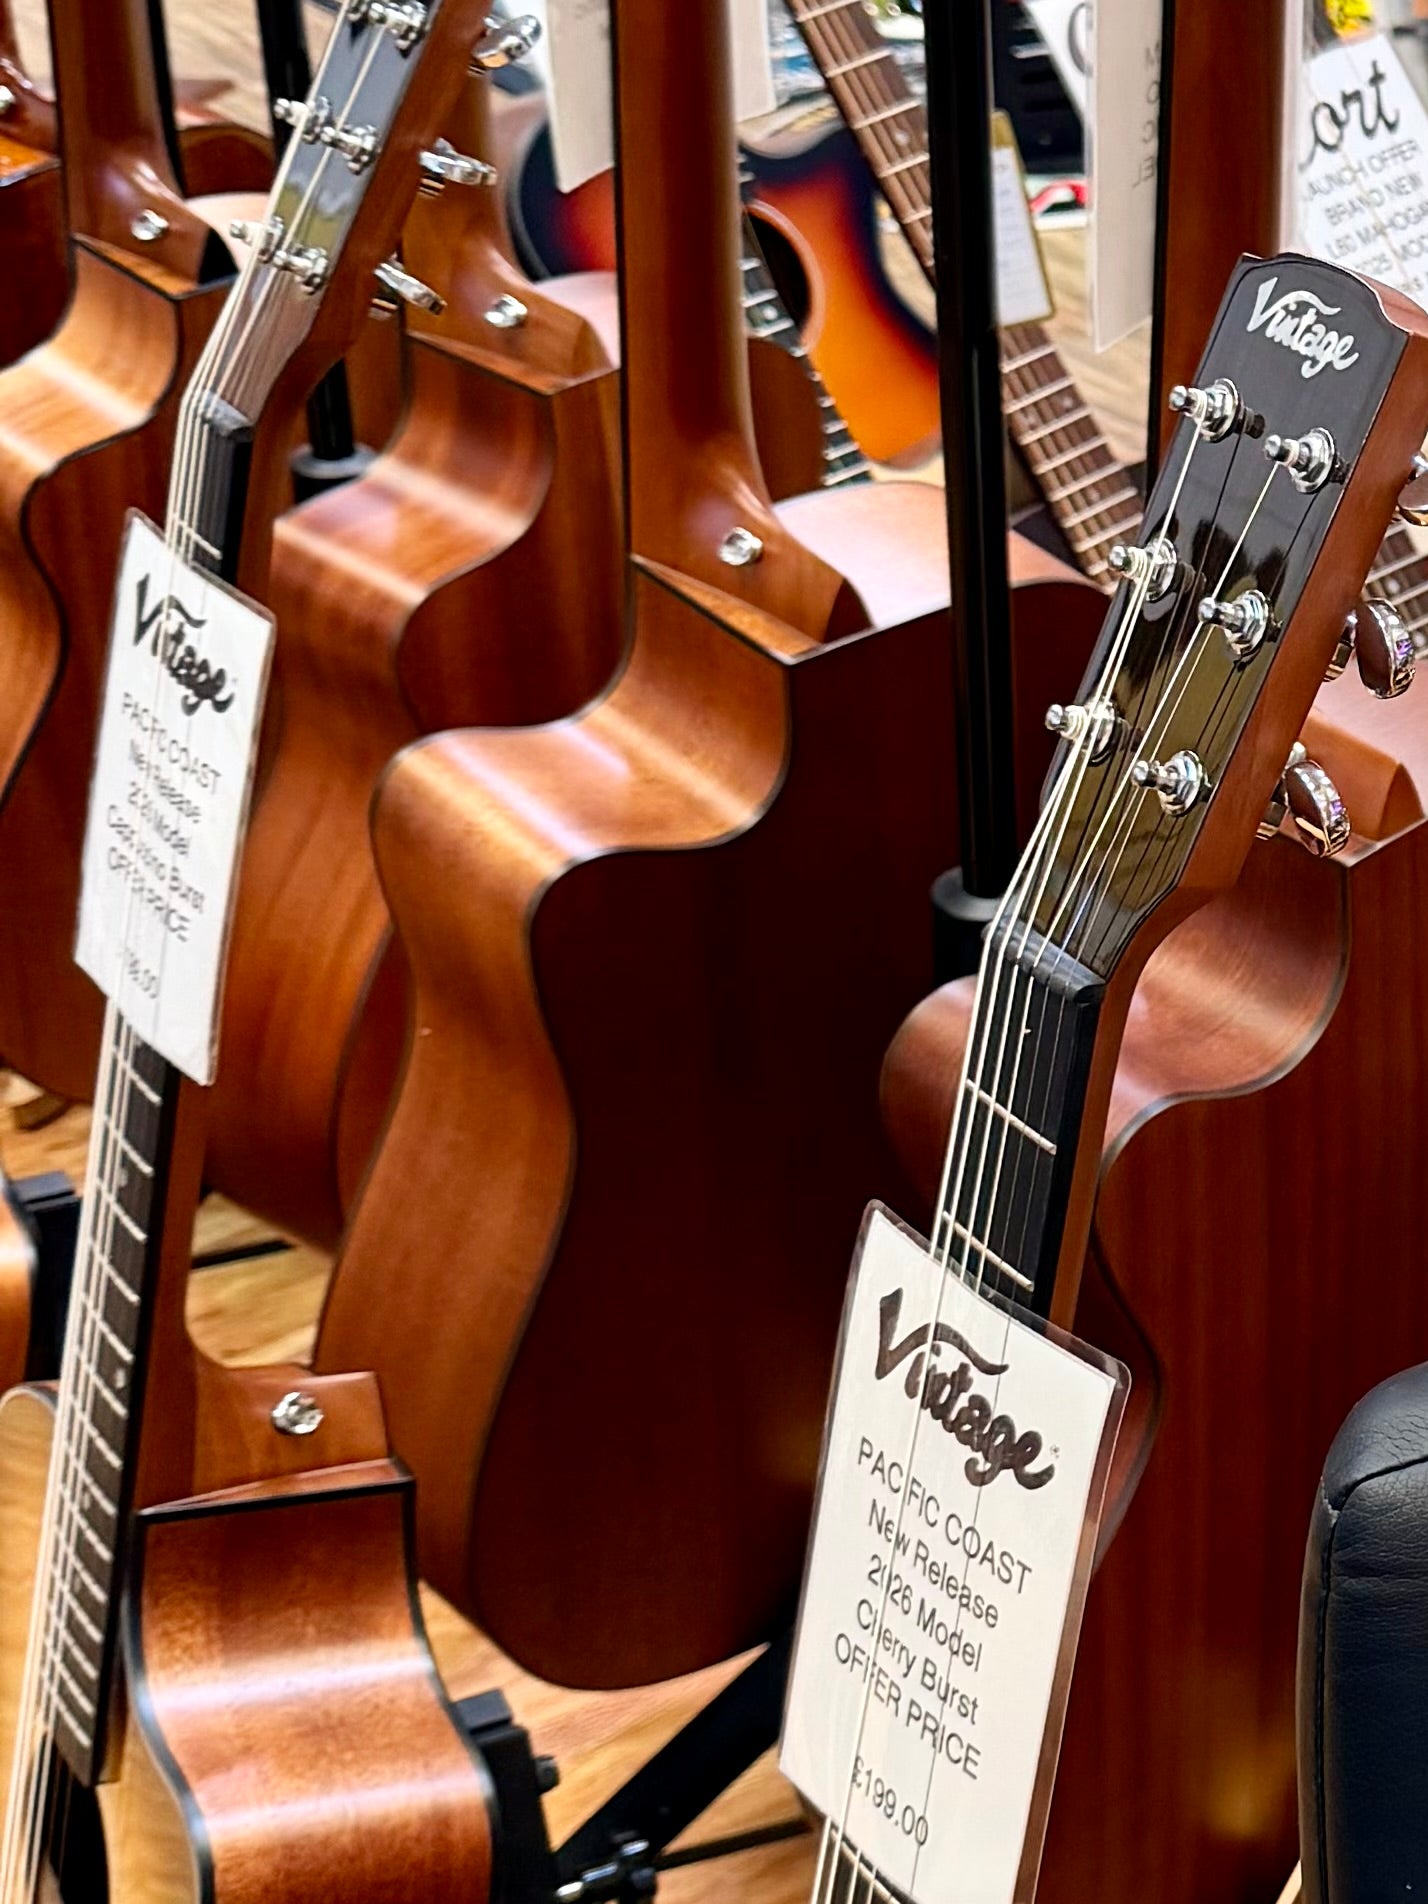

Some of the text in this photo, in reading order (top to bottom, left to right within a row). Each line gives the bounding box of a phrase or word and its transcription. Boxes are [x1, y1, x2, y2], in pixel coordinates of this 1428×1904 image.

[1303, 59, 1399, 164] ort
[1247, 277, 1359, 378] Vintage
[133, 573, 236, 717] Vintage
[875, 1287, 1055, 1491] Vintage
[859, 1437, 1033, 1594] PACFIC COAST
[869, 1498, 998, 1629] New Release
[917, 1598, 982, 1672] Model
[905, 1699, 981, 1780] PRICE
[920, 1657, 978, 1725] Burst
[851, 1756, 929, 1846] £199.00
